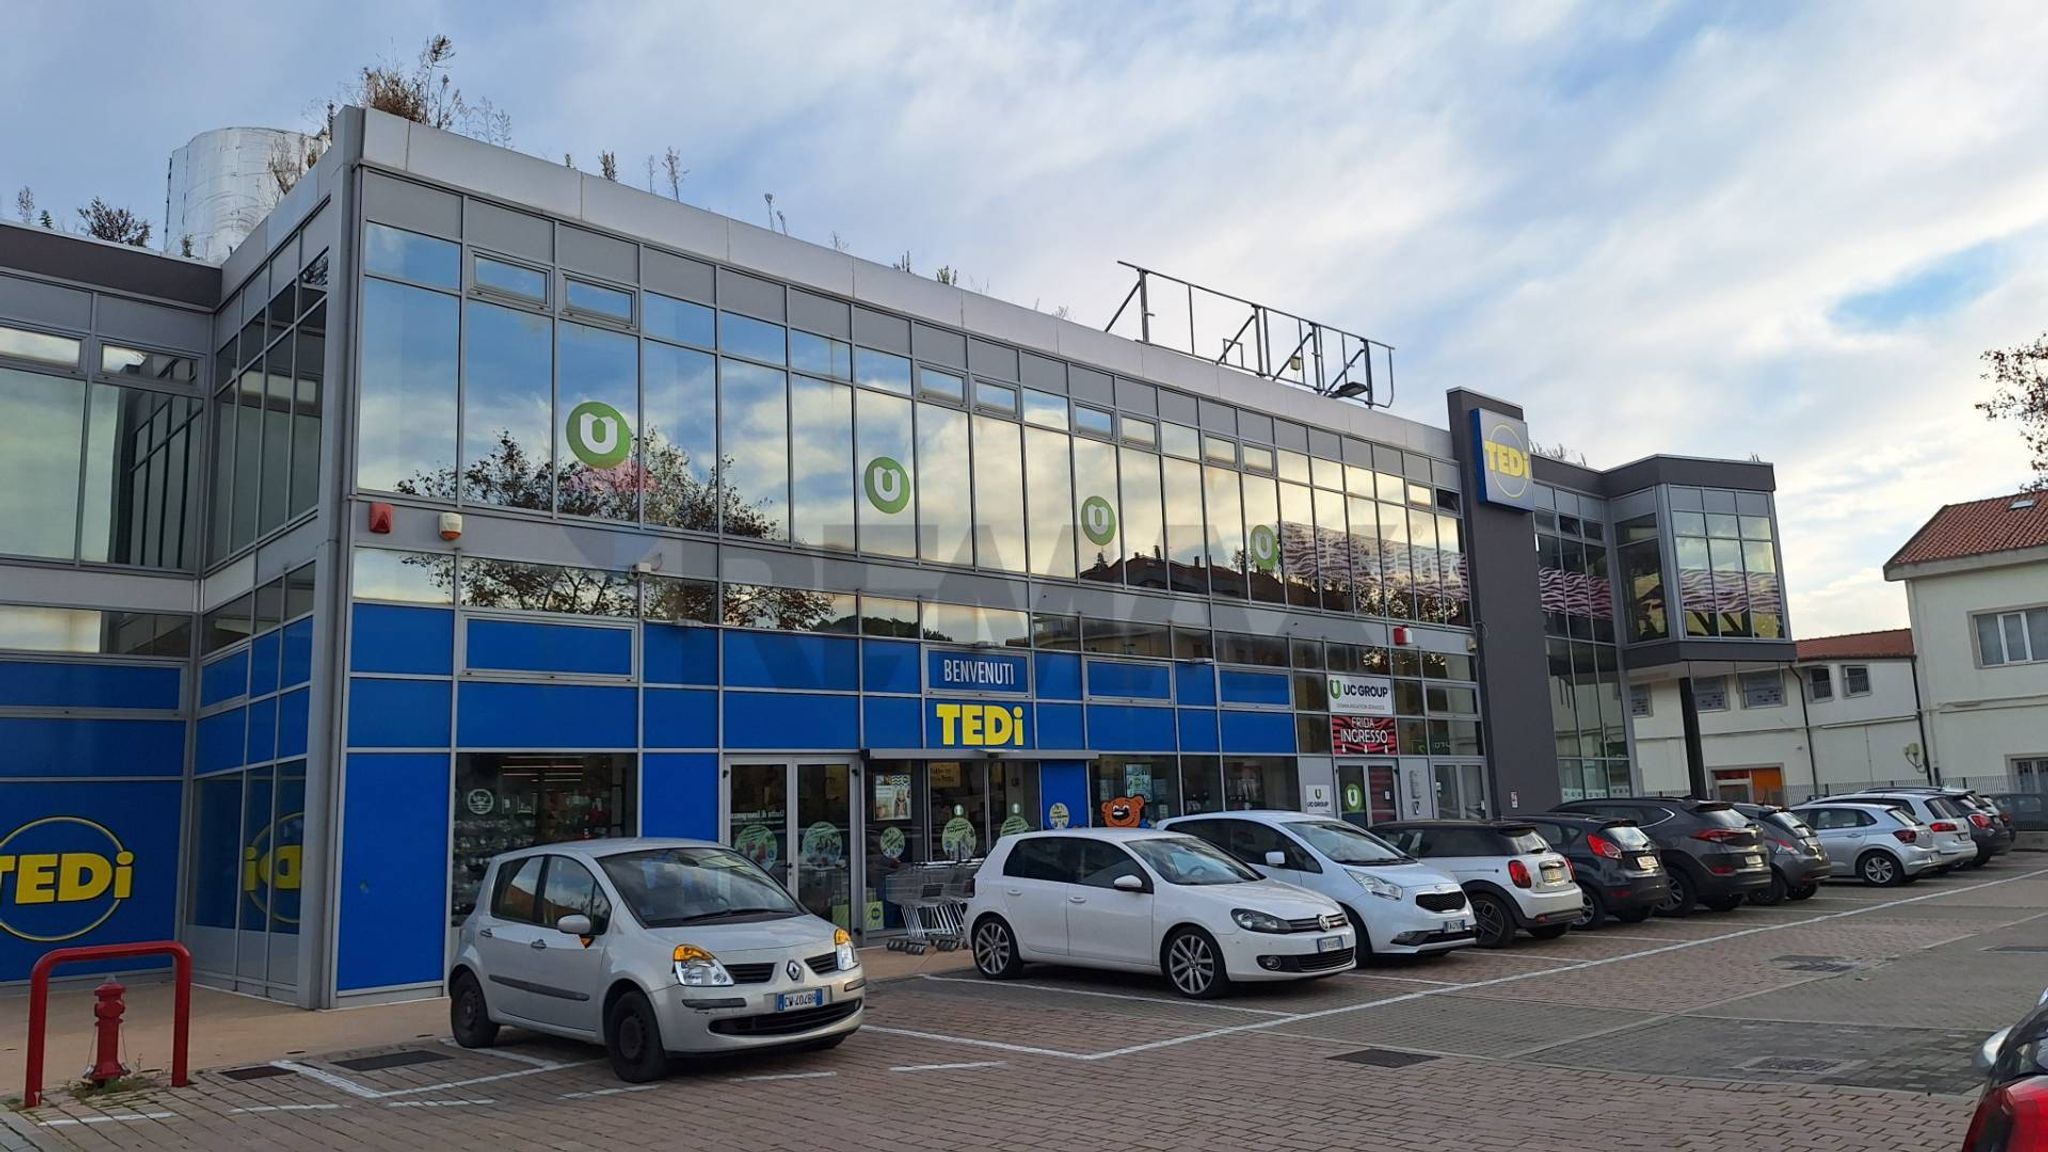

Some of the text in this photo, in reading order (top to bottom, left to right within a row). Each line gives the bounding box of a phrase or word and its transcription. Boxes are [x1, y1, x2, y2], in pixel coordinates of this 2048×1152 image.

[1485, 440, 1529, 479] TEDi
[943, 659, 1015, 685] BENVENUTI
[1343, 684, 1357, 696] UC
[1358, 685, 1388, 698] GROUP
[936, 704, 1025, 746] TEDi
[1351, 716, 1375, 729] FRIDA
[1340, 728, 1388, 744] INGRESSO
